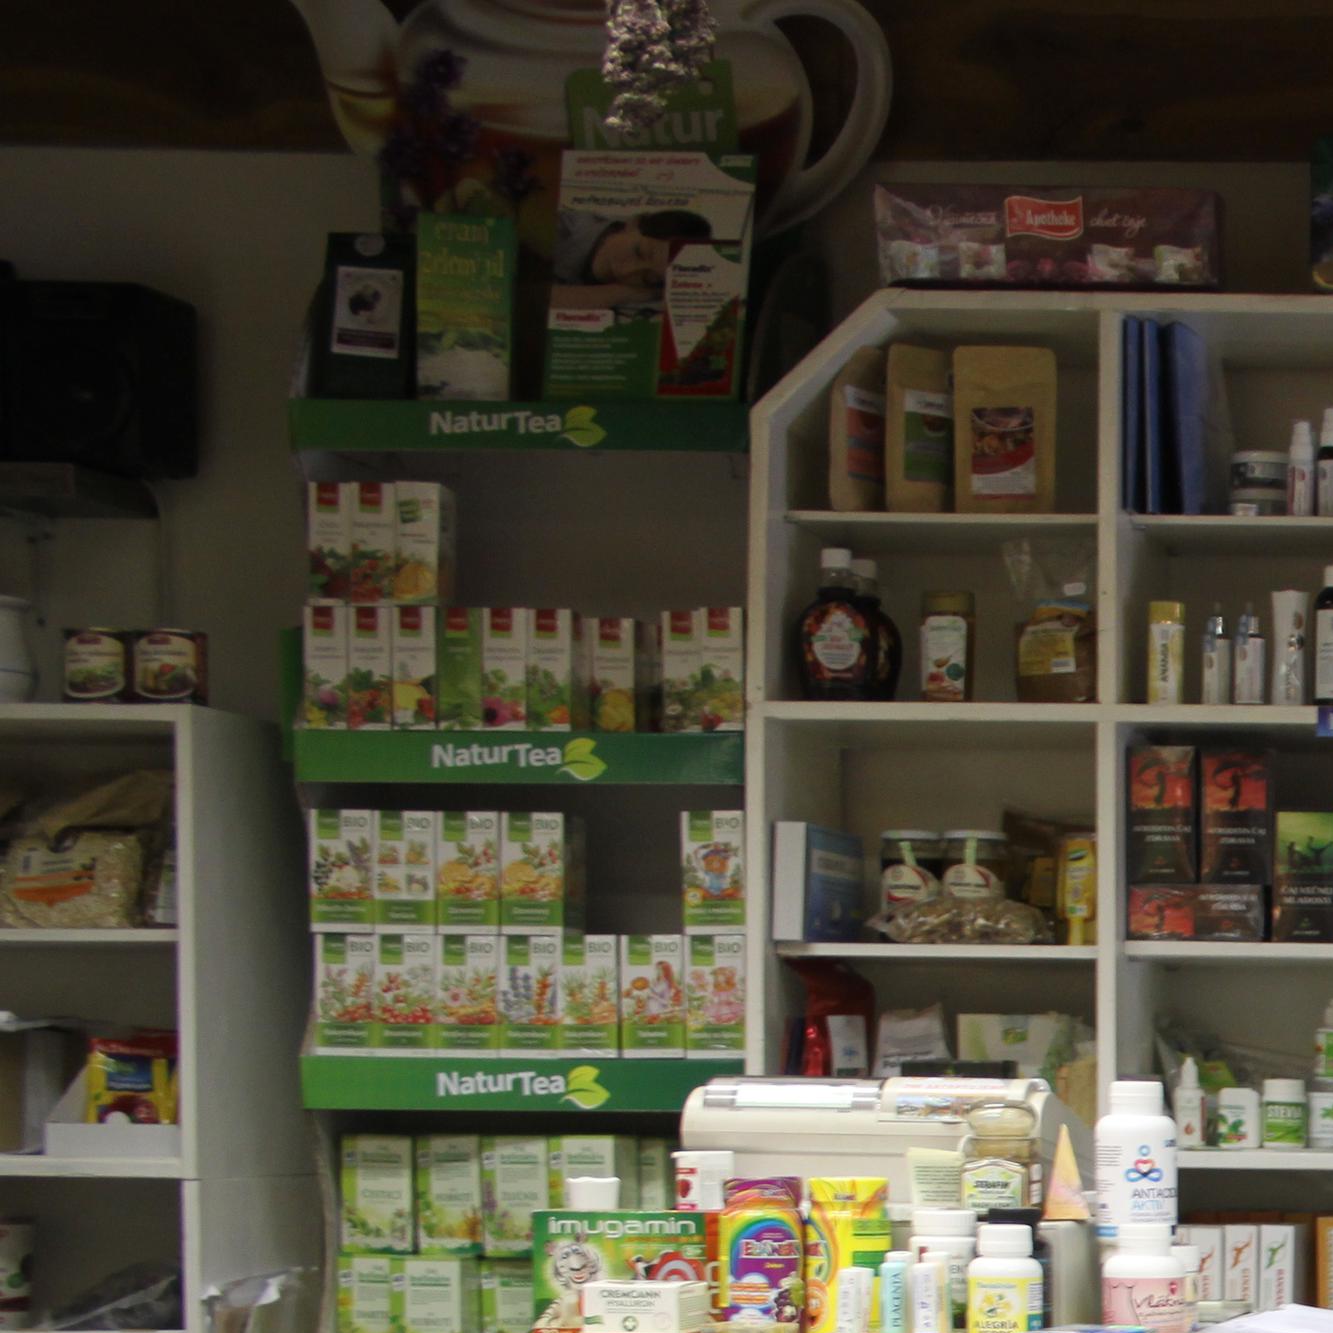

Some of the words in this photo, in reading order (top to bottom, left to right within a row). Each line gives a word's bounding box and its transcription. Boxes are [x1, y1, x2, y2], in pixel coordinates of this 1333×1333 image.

[430, 410, 562, 436] NaturTea
[432, 743, 562, 769] NaturTea
[436, 1071, 565, 1097] NaturTea
[547, 1216, 697, 1238] imugamin
